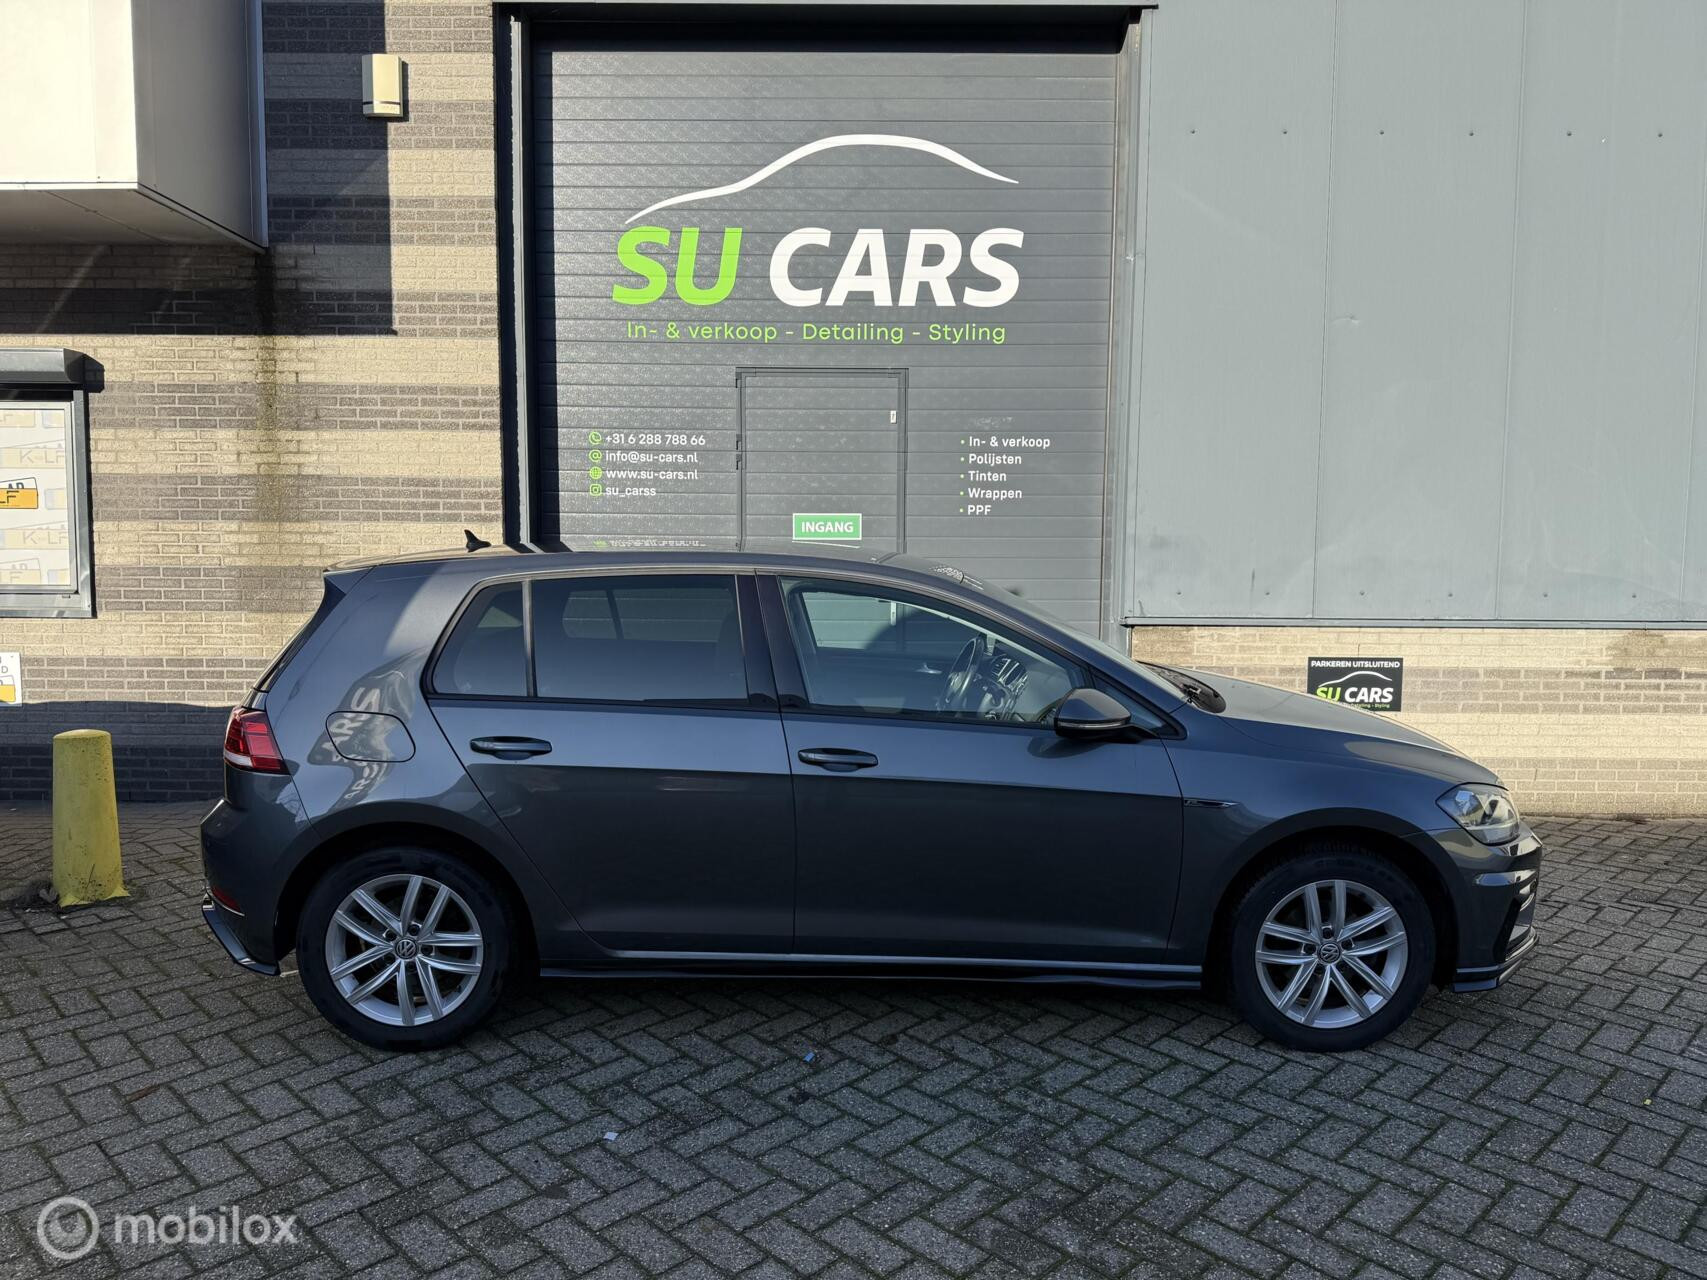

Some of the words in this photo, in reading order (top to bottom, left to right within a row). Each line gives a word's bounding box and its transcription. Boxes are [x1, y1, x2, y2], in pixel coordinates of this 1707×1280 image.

[612, 226, 743, 305] SU
[769, 227, 1024, 307] CARS
[627, 321, 657, 339] In-
[666, 322, 681, 339] &
[688, 323, 777, 343] verkoop
[803, 323, 903, 343] Detailing
[928, 323, 1006, 344] Styling
[639, 434, 662, 445] 288
[665, 434, 688, 446] 788
[690, 435, 706, 446] 66
[969, 436, 986, 447] In-
[989, 436, 999, 447] &
[1002, 436, 1050, 449] verkoop
[605, 450, 698, 463] info@su-cars.nl
[968, 453, 1022, 467] Polijsten
[605, 469, 698, 480] www.su-cars.nl
[968, 470, 1007, 482] Tinten
[605, 486, 656, 497] su_carss
[968, 487, 1022, 500] Wrappen
[967, 505, 992, 515] PPF
[801, 521, 854, 533] INGANG
[1311, 660, 1351, 668] PARKEREN
[1352, 660, 1400, 668] UITSLUITEND
[1316, 687, 1341, 702] SU
[1344, 687, 1394, 703] CARS
